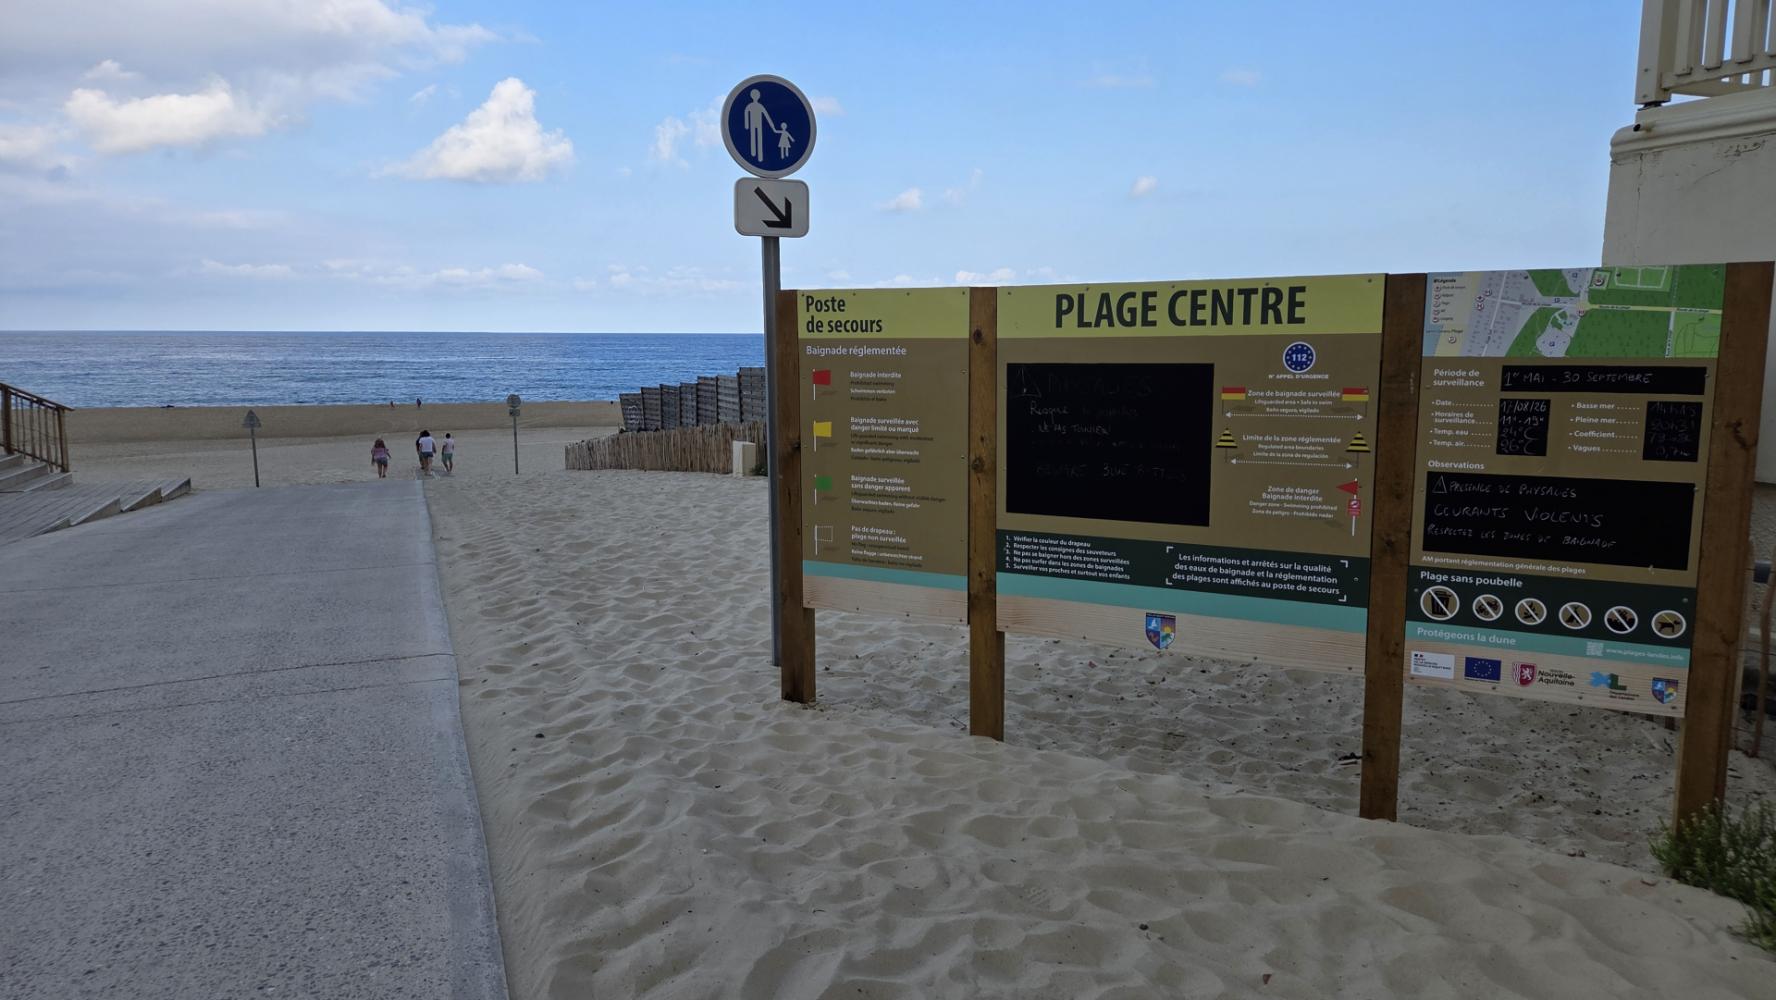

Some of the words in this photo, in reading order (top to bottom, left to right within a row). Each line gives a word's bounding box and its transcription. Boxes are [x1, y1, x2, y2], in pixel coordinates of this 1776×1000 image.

[805, 295, 846, 313] Poste
[1055, 291, 1158, 329] PLAGE
[1167, 286, 1306, 327] CENTRE
[806, 315, 824, 333] de
[827, 319, 883, 333] secours
[806, 345, 848, 357] Baignade
[849, 345, 907, 357] réglementée
[1291, 353, 1308, 362] 112
[850, 371, 877, 379] Baignade
[877, 371, 902, 379] interdite
[1433, 368, 1468, 378] Période
[1468, 369, 1480, 377] de
[1562, 371, 1580, 384] 30
[1433, 378, 1485, 387] surveillance
[1275, 390, 1307, 399] baignade
[1308, 391, 1341, 399] surveillée
[850, 416, 877, 425] Baignade
[877, 417, 905, 425] surveillée
[1434, 417, 1476, 425] surveillance
[850, 424, 871, 432] danger
[1433, 428, 1455, 436] Temp.
[1574, 430, 1615, 438] Coefficient
[1298, 435, 1342, 444] réglementée
[1433, 439, 1454, 447] Temp.
[1572, 445, 1601, 454] Vagues
[1427, 459, 1485, 470] Observations
[851, 474, 877, 483] Baignade
[878, 476, 905, 484] surveillée
[864, 483, 884, 491] danger
[1295, 486, 1320, 495] danger
[1262, 493, 1293, 501] Baignade
[1294, 493, 1323, 502] interdite
[1524, 507, 1604, 528] VIOLENTS
[869, 527, 893, 535] drapeau
[851, 533, 867, 541] plage
[880, 535, 907, 544] surveillée
[1068, 540, 1091, 548] drapeau
[1178, 553, 1191, 561] Les
[1192, 554, 1240, 566] informations
[1250, 559, 1279, 569] arrêtés
[1279, 562, 1293, 570] sur
[1294, 561, 1302, 570] la
[1302, 562, 1332, 574] qualité
[1434, 557, 1460, 565] portant
[1461, 558, 1514, 568] réglementation
[1515, 562, 1546, 571] générale
[1561, 566, 1586, 575] plages
[1049, 567, 1070, 575] proches
[1174, 563, 1188, 571] des
[1208, 565, 1218, 573] de
[1219, 566, 1256, 578] baignade
[1257, 569, 1265, 577] et
[1266, 569, 1274, 578] la
[1275, 570, 1338, 584] réglementation
[1172, 572, 1185, 581] des
[1186, 573, 1211, 584] plages
[1212, 576, 1229, 585] sont
[1230, 577, 1260, 588] affichés
[1261, 580, 1271, 588] au
[1272, 580, 1295, 592] poste
[1296, 582, 1306, 591] de
[1308, 584, 1340, 595] secours
[1420, 570, 1449, 583] Plage
[1450, 574, 1473, 584] sans
[1475, 577, 1523, 588] poubelle
[1417, 627, 1475, 641] Protégeons
[1477, 632, 1487, 642] la
[1488, 634, 1517, 645] dune
[1538, 677, 1575, 687] Aquitaine
